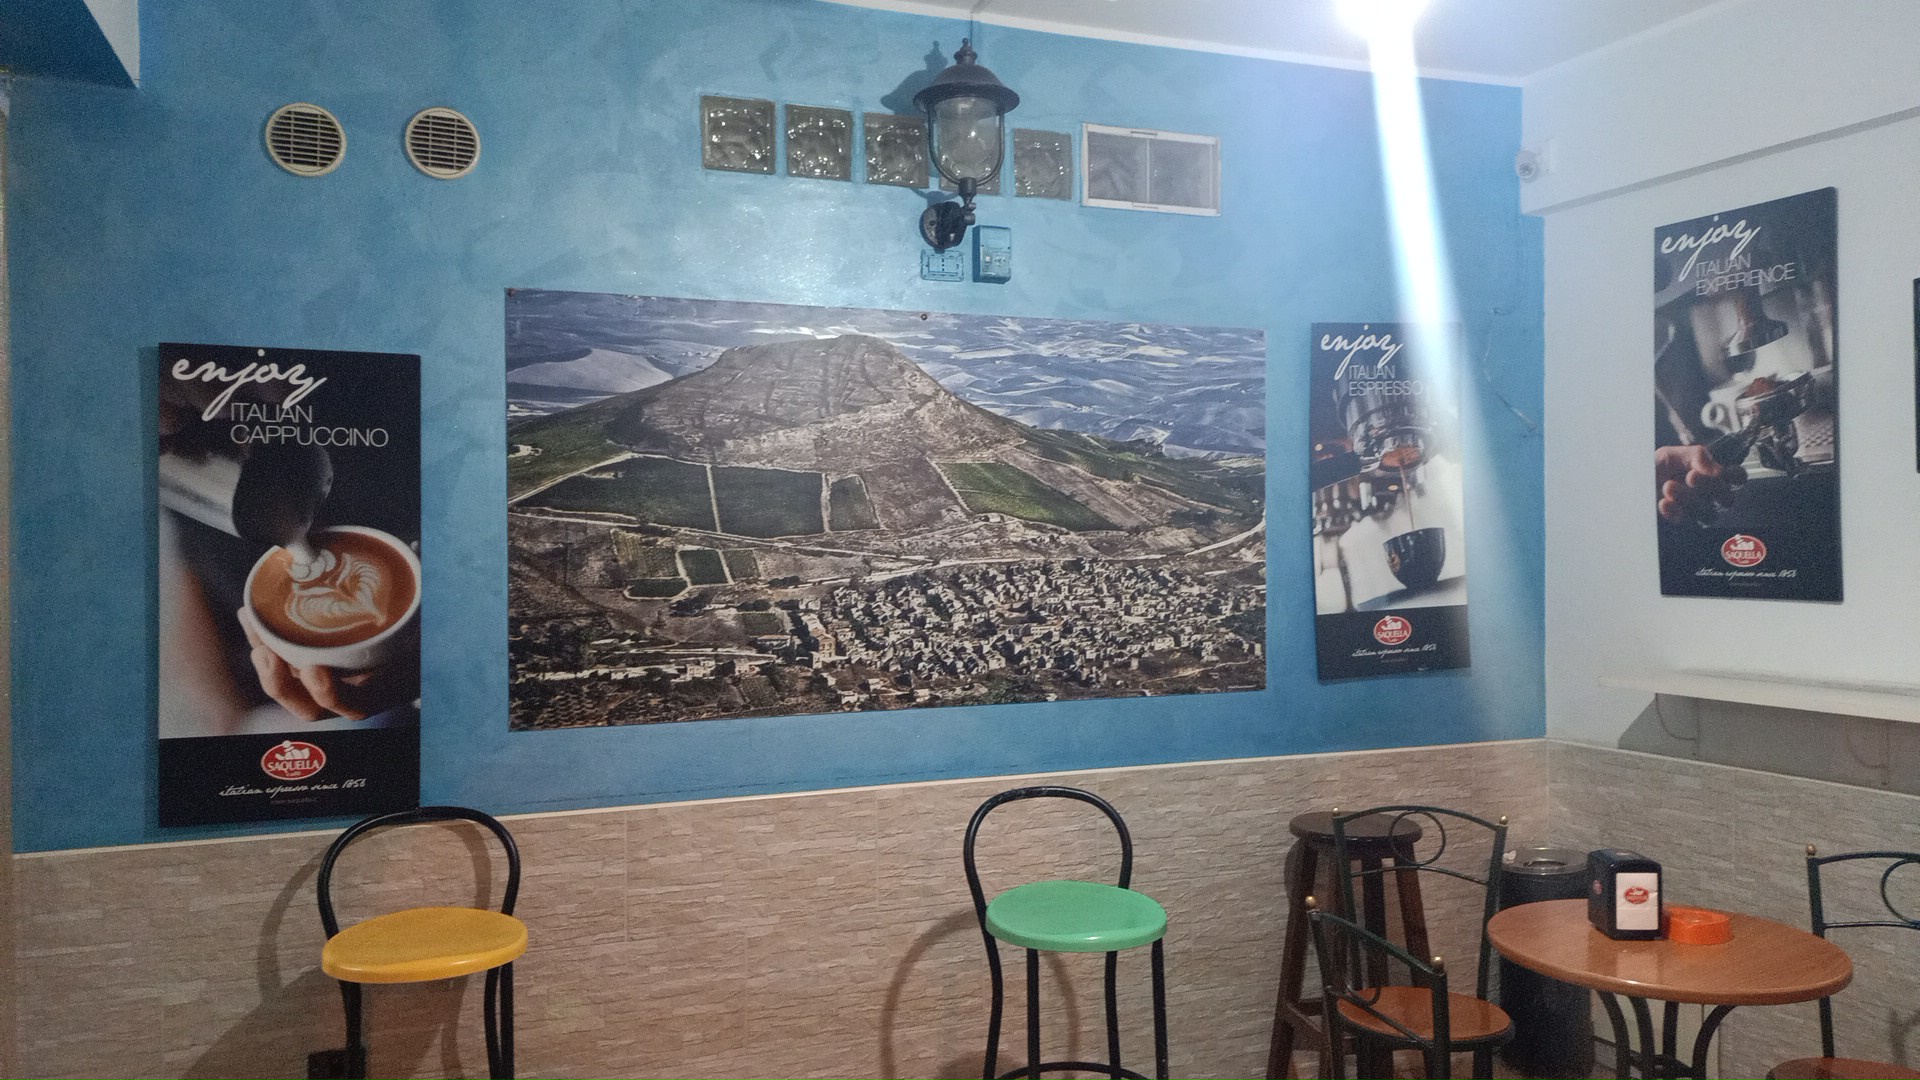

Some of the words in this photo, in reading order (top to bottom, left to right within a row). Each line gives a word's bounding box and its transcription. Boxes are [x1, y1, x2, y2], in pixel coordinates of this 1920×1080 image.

[1661, 215, 1761, 282] enjoy
[1696, 253, 1752, 278] ITALIAN
[1695, 262, 1796, 297] EXPERIENCE
[1321, 324, 1404, 380] enjoy
[1349, 365, 1396, 379] ITALIAN
[172, 349, 328, 422] enjoy
[1349, 380, 1424, 396] ESPRESSO
[230, 402, 313, 423] ITALIAN
[230, 424, 389, 447] CAPPUCCINO
[268, 760, 320, 774] SAQUELLA
[218, 785, 264, 797] italian
